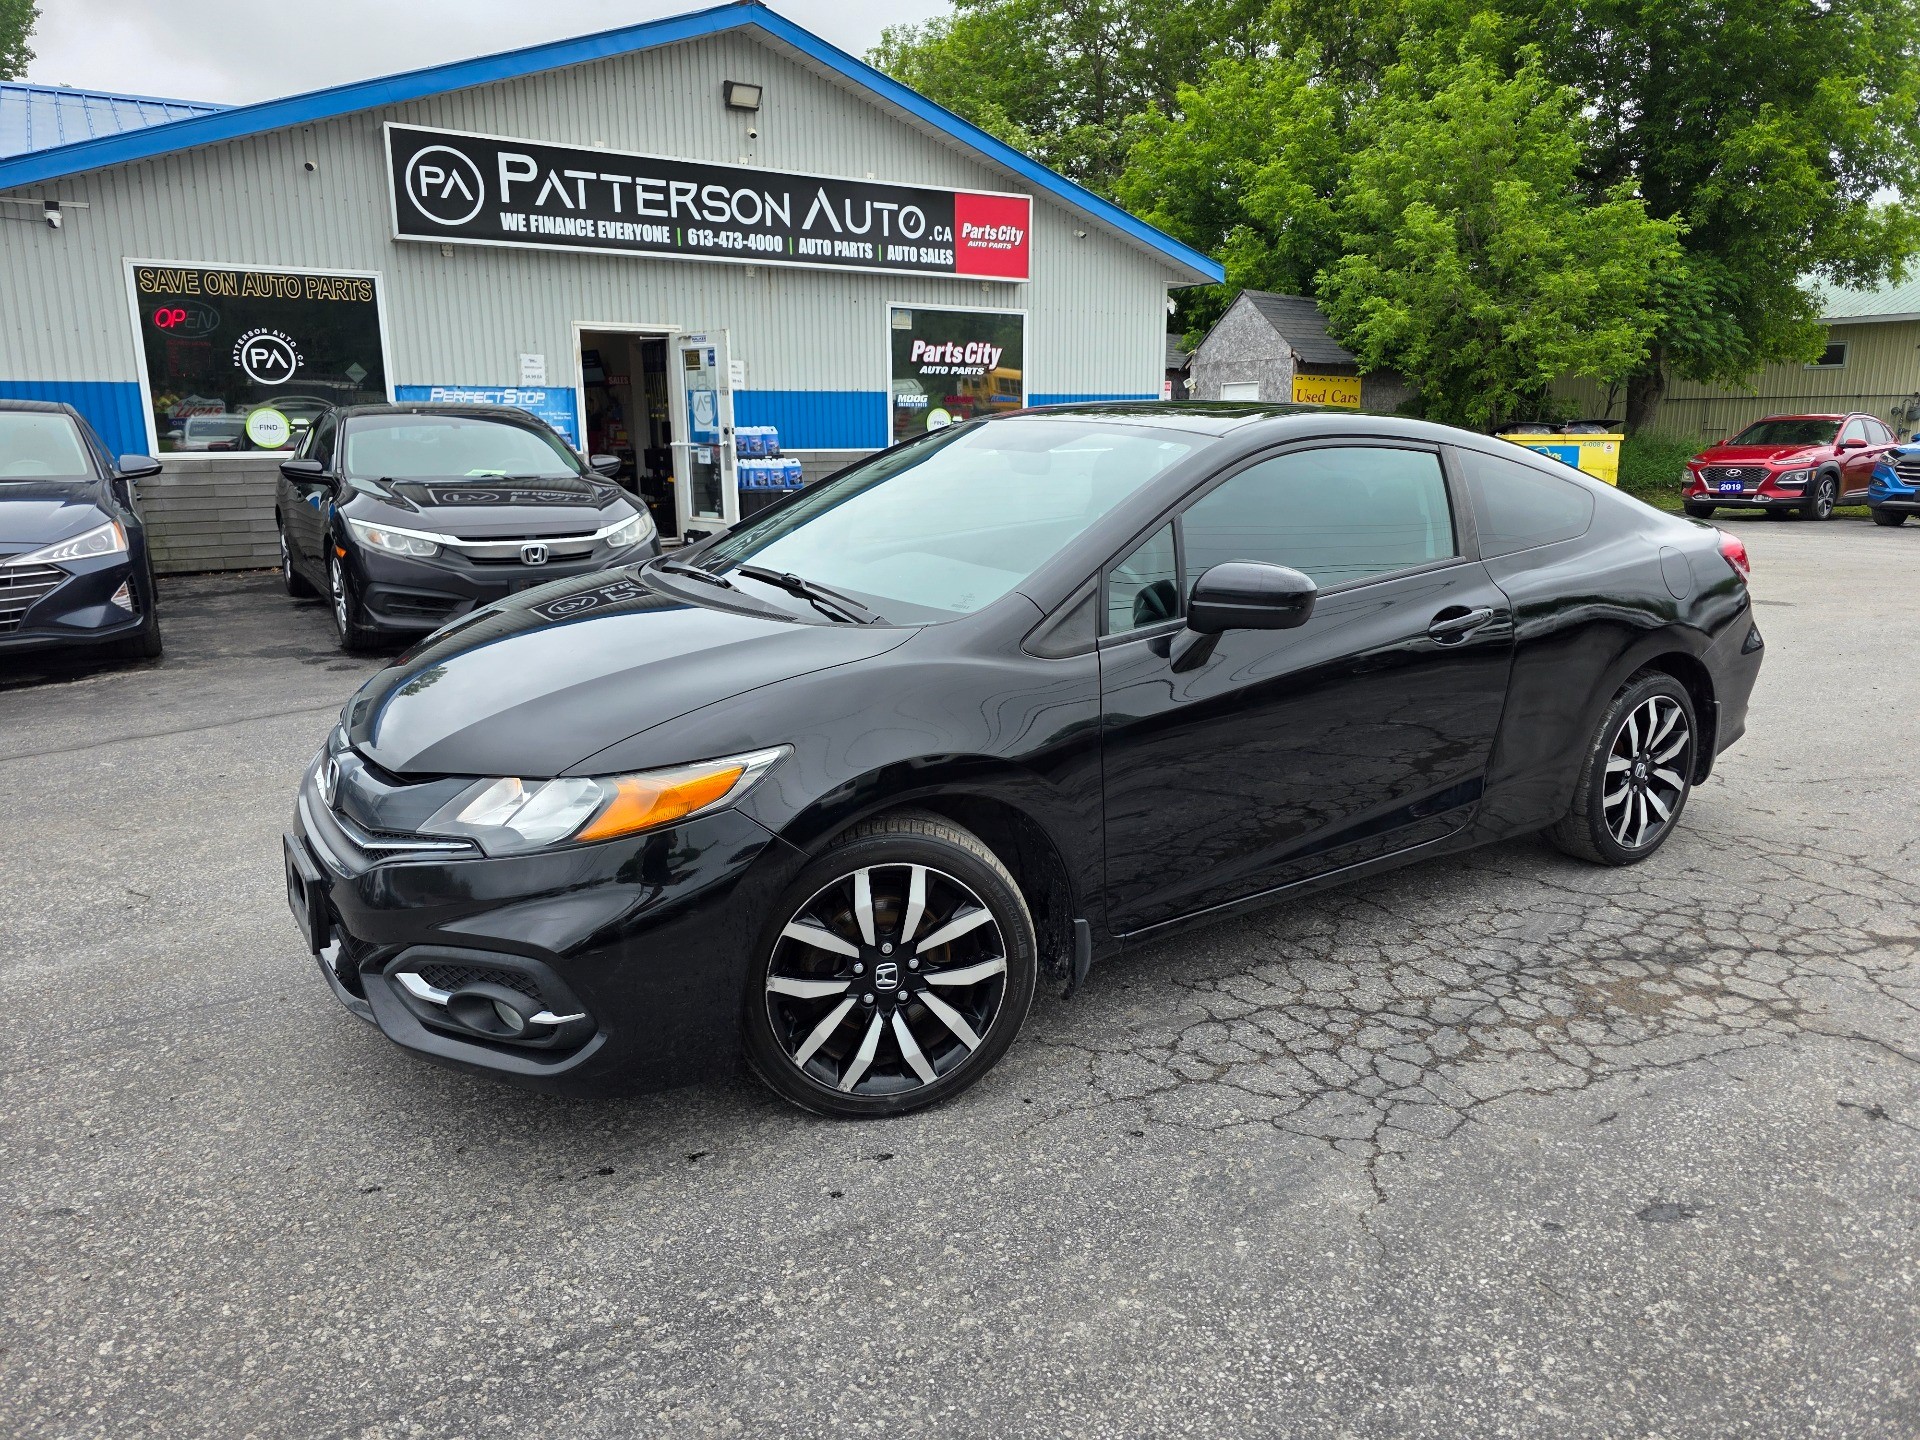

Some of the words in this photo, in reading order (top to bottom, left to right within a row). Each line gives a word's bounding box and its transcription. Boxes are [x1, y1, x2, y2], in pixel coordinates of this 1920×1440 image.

[418, 164, 474, 201] PA
[497, 151, 791, 228] PATTERSON
[801, 186, 926, 240] AUTO
[500, 211, 528, 232] WE
[529, 214, 596, 237] FINANCE
[597, 220, 671, 244] EVERYONE
[687, 228, 783, 253] 613-473-4000
[798, 237, 833, 256] AUTO
[834, 240, 873, 259] PARTS
[887, 244, 919, 262] AUTO
[920, 247, 954, 265] SALES
[967, 240, 987, 248] AUTO
[988, 241, 1012, 250] PARTS
[139, 268, 200, 294] SAVE
[204, 271, 238, 296] ON
[242, 272, 301, 298] AUTO
[305, 276, 373, 302] PARTS
[154, 307, 214, 329] OPEN
[232, 327, 268, 367] PATTERSON
[272, 329, 297, 348] AUTO
[250, 348, 289, 369] PA
[919, 365, 948, 375] AUTO
[950, 366, 985, 375] PARTS
[897, 394, 929, 403] MOOG
[1296, 388, 1327, 403] Used
[1331, 389, 1359, 404] Cars
[259, 423, 278, 431] FIND
[1720, 483, 1741, 491] 2019
